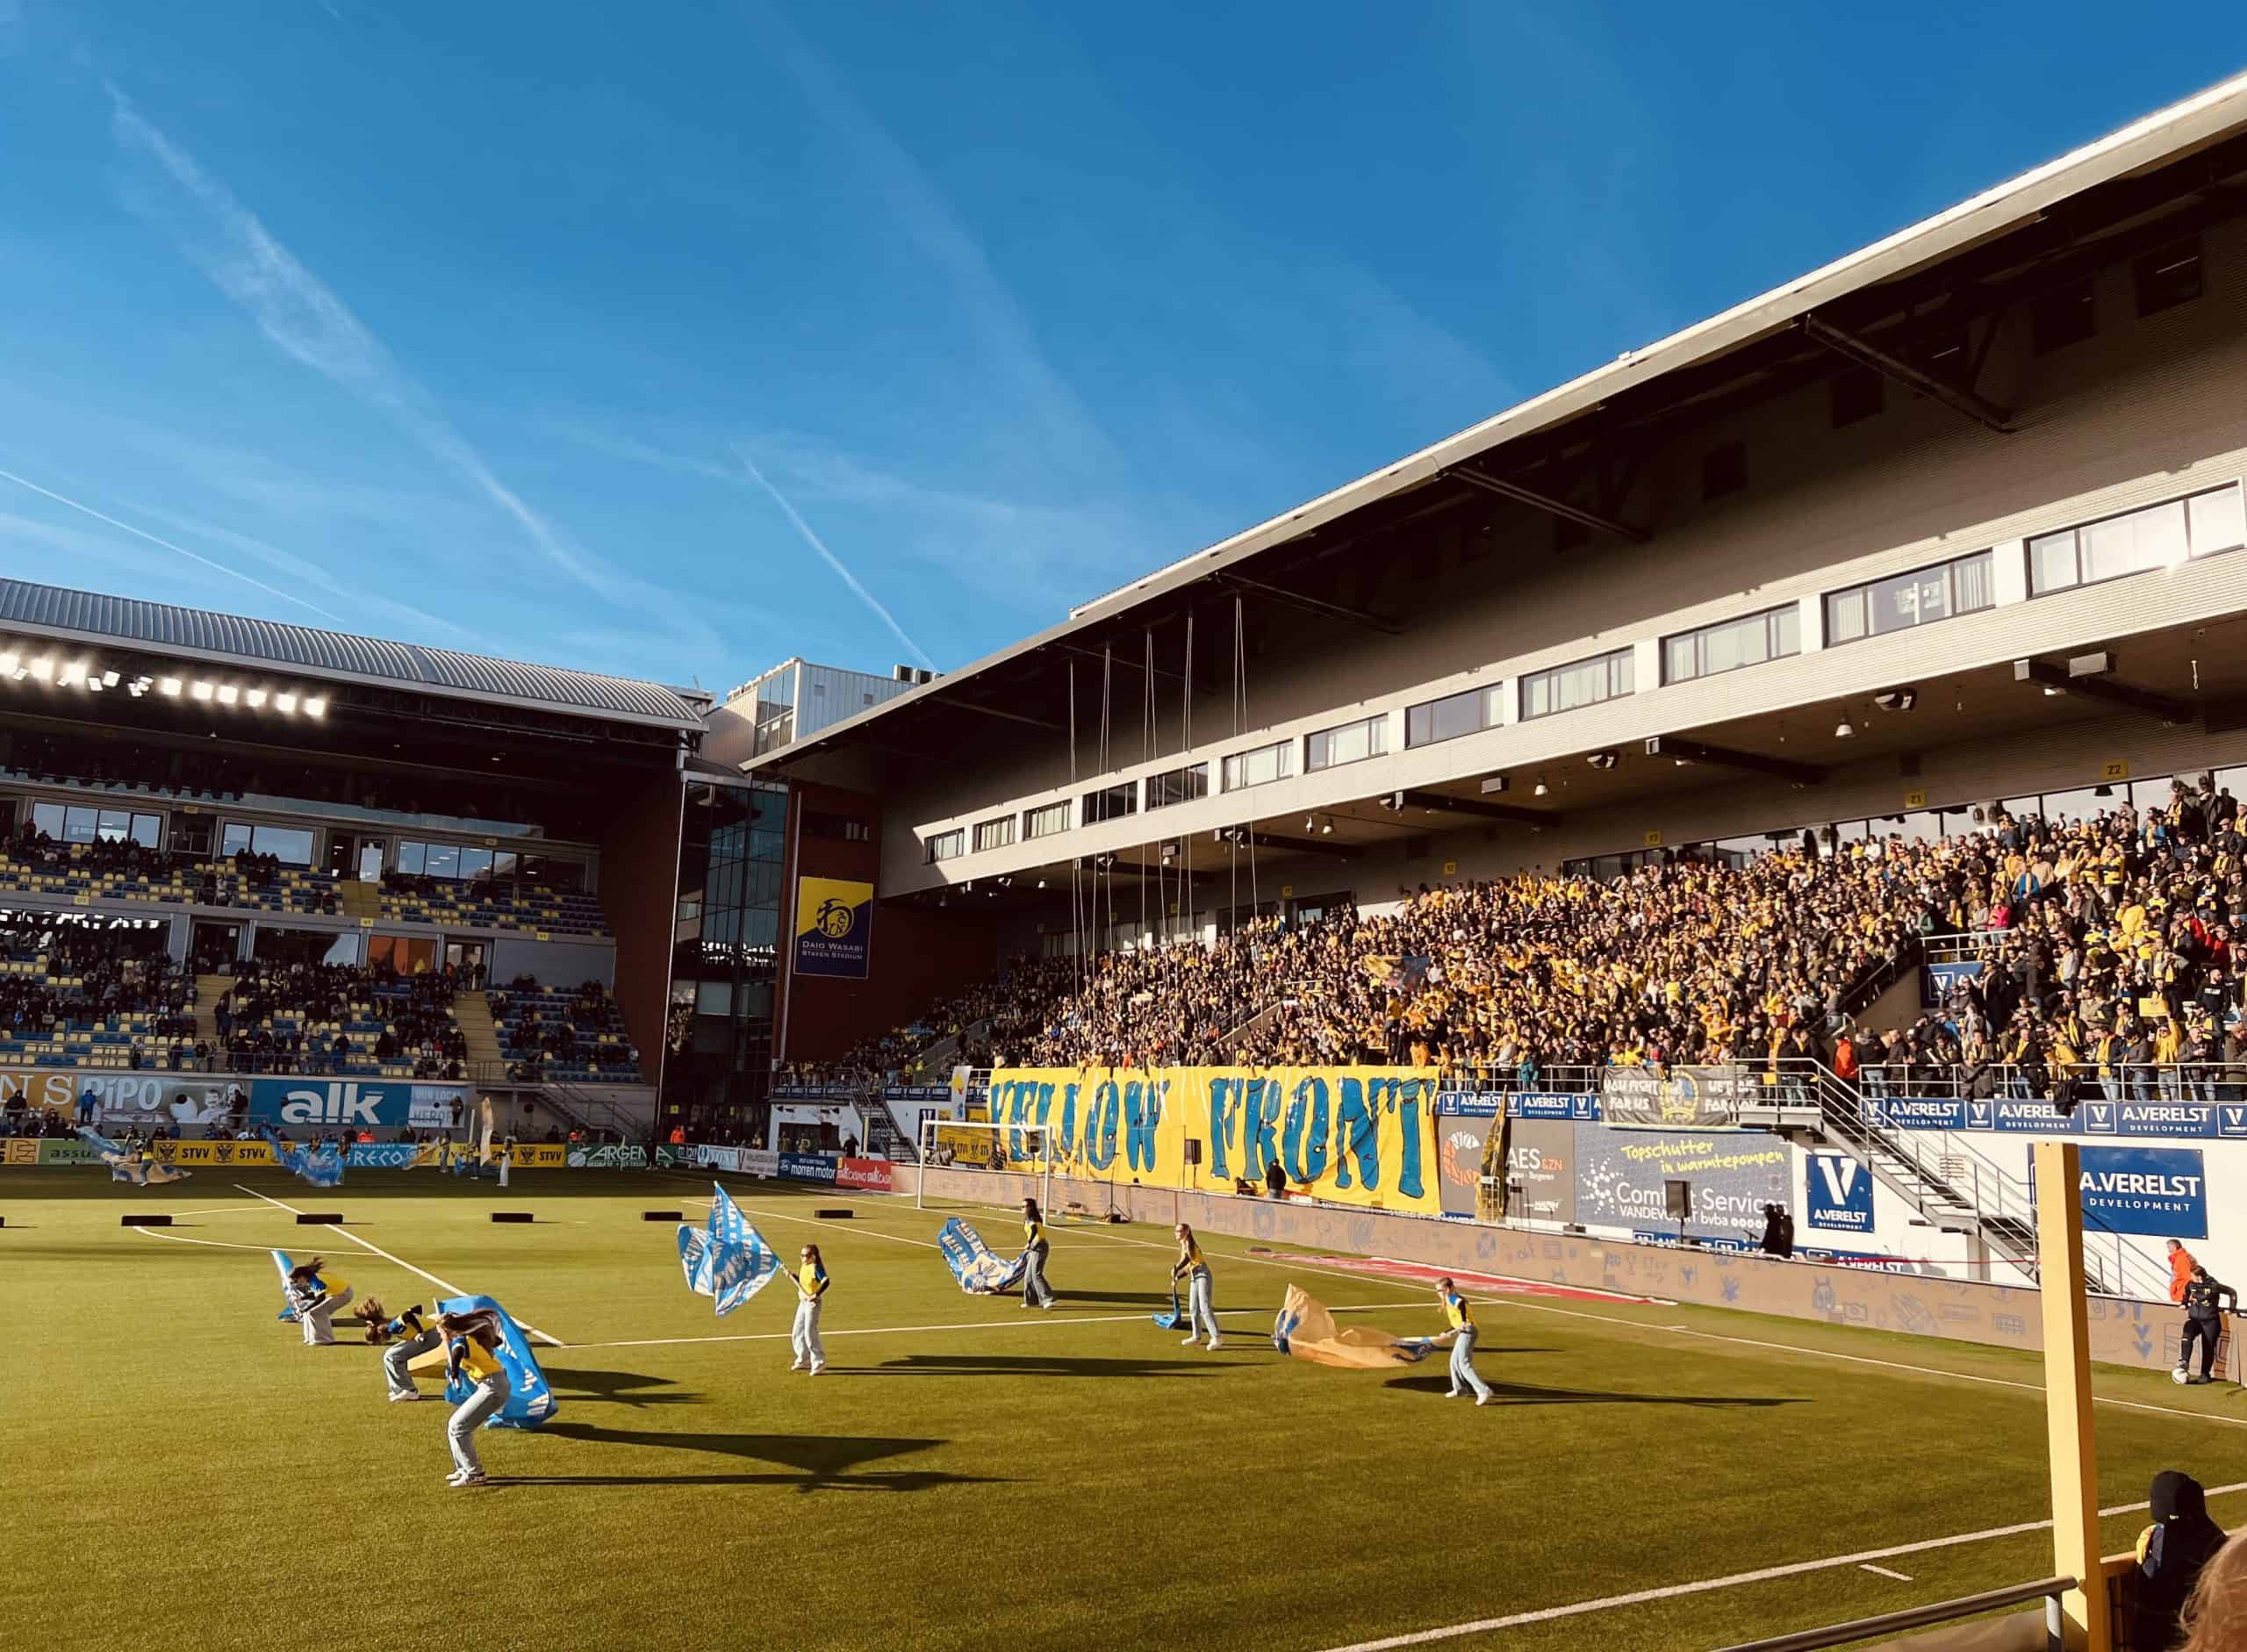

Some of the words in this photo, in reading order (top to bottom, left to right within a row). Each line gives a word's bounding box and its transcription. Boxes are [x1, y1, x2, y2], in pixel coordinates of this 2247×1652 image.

[2107, 765, 2121, 775] Z2
[802, 941, 826, 950] DAIO
[829, 942, 863, 953] WASABI
[281, 1082, 386, 1124] alk
[1525, 1097, 1569, 1109] A.VERELST
[1890, 1103, 1959, 1117] A.VERELST
[1999, 1104, 2075, 1119] A.VEREL
[2122, 1107, 2210, 1124] A.VERELST
[1210, 1076, 1436, 1200] FRONT
[182, 1147, 210, 1160] STVV
[239, 1147, 266, 1160] STVV
[539, 1151, 562, 1161] STVV
[587, 1145, 674, 1161] ARGENA
[1621, 1139, 1713, 1161] Topschutter
[1660, 1160, 1673, 1174] in
[1677, 1150, 1784, 1173] warmtepompen
[2079, 1172, 2200, 1197] A.VERELST
[1617, 1182, 1696, 1209] Comft
[2089, 1197, 2191, 1211] DEVELOPMENT
[1619, 1206, 1698, 1223] VANDEVT
[1701, 1212, 1728, 1226] bvba
[1814, 1209, 1867, 1223] A.VERELST
